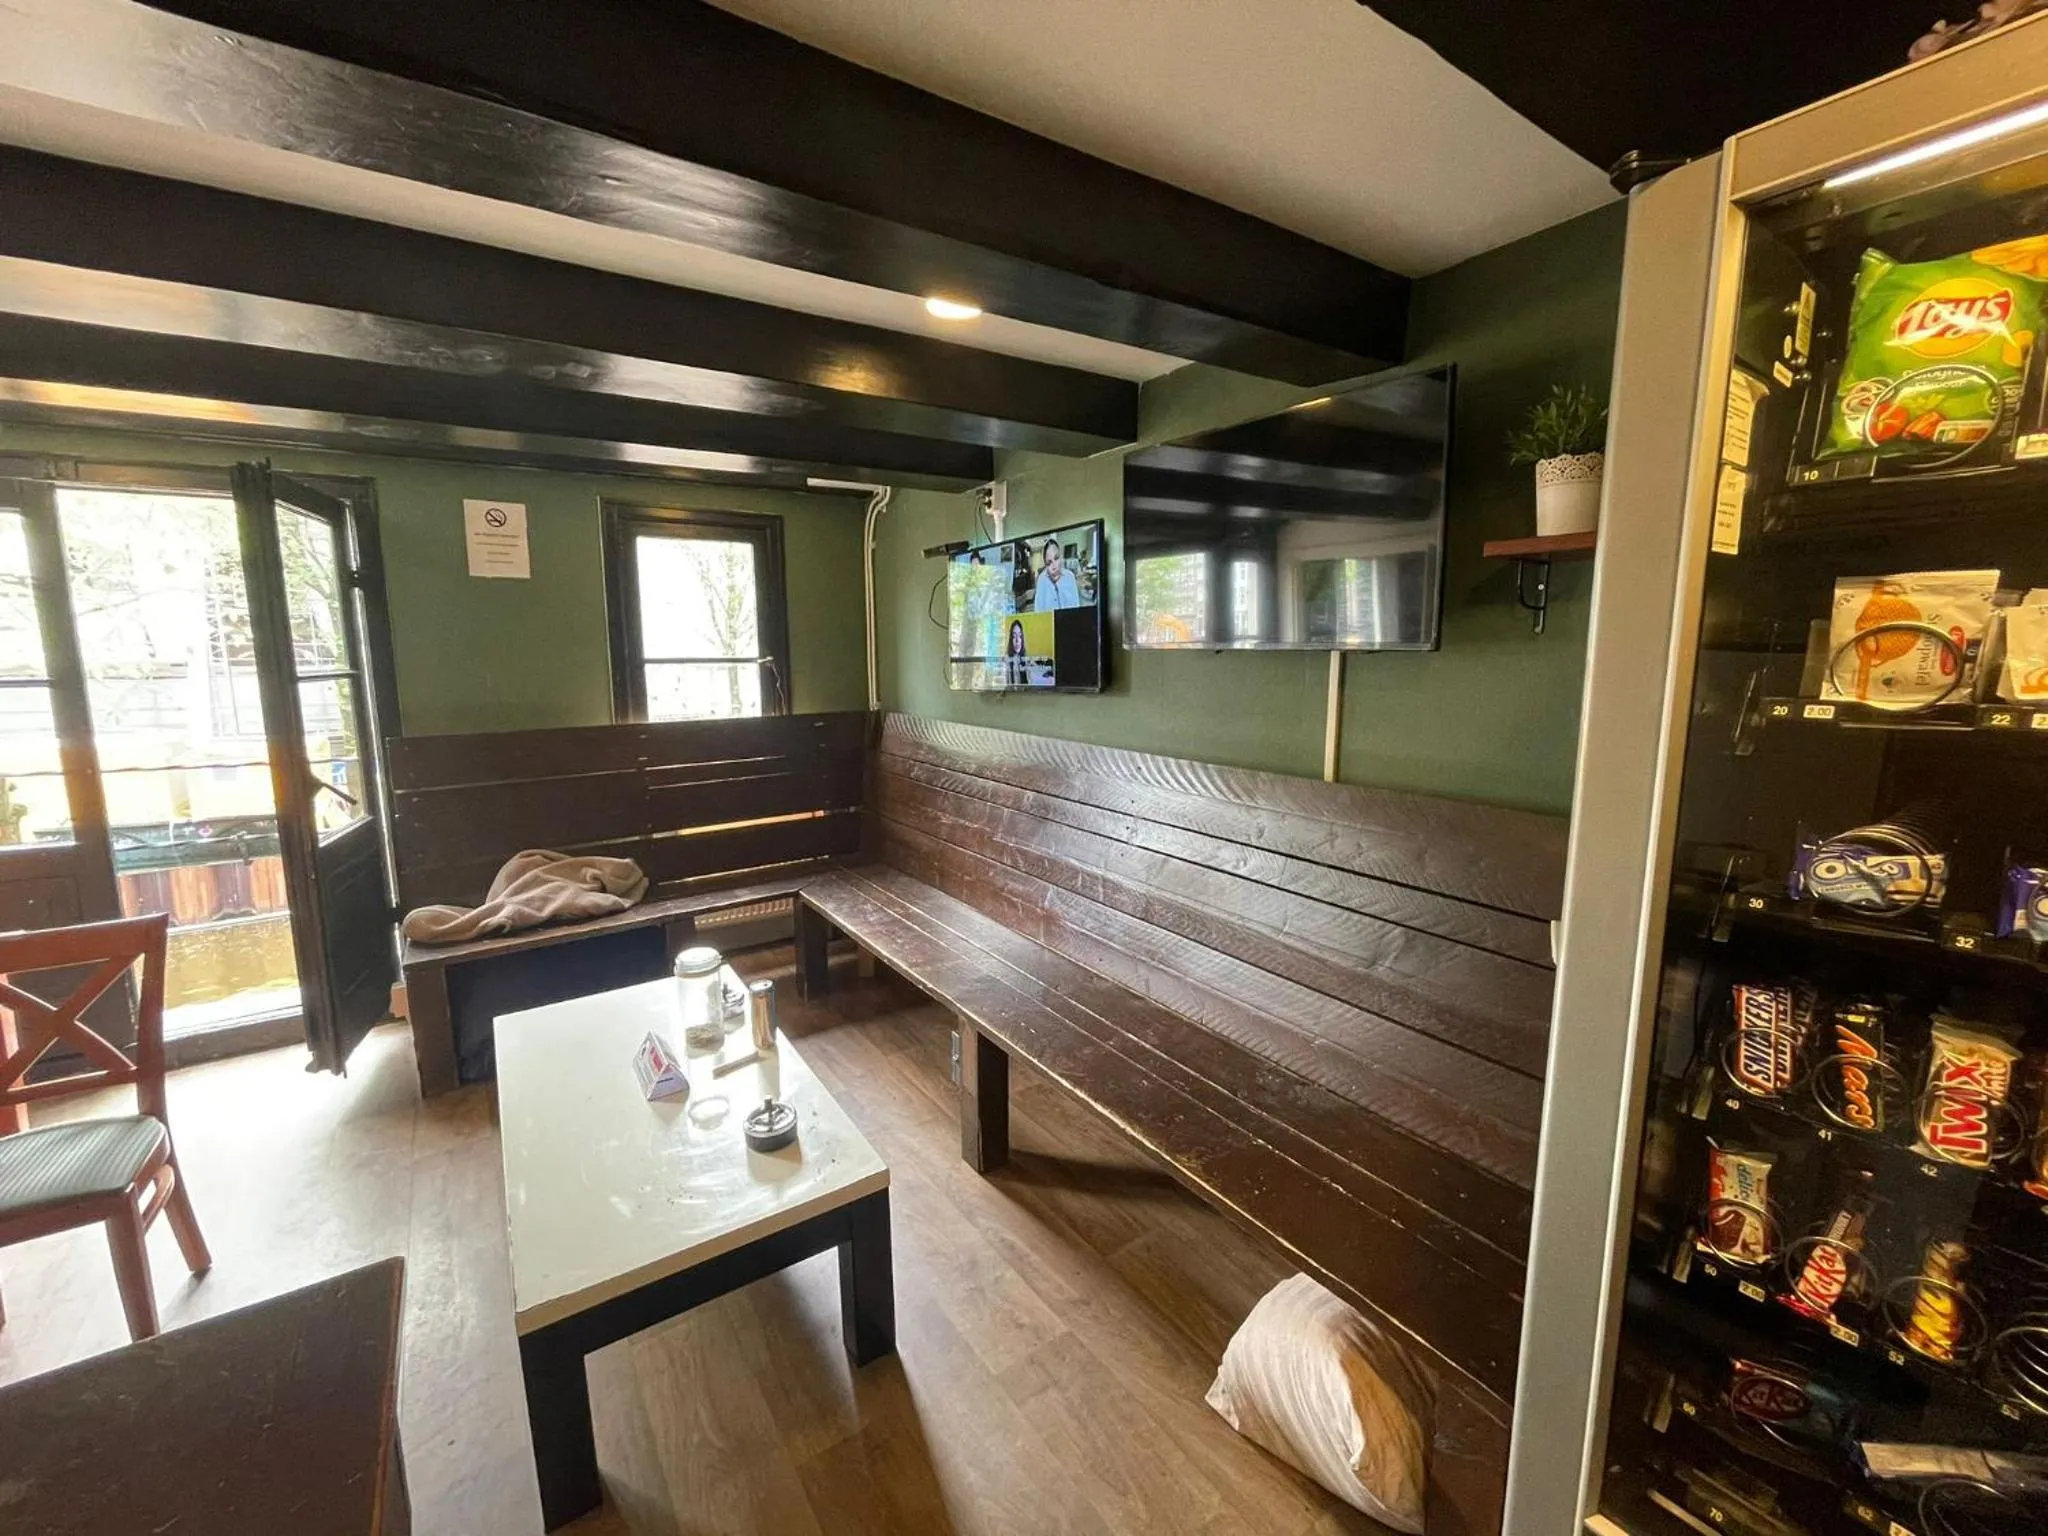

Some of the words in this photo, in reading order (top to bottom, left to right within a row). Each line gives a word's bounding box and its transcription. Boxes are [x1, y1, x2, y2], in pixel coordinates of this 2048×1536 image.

[1803, 470, 1819, 481] 10
[1772, 704, 1789, 716] 20
[1991, 714, 2011, 725] 22
[1748, 897, 1764, 909] 30
[1954, 935, 1975, 949] 32
[1725, 1098, 1740, 1111] 40
[1817, 1127, 1833, 1142] 41
